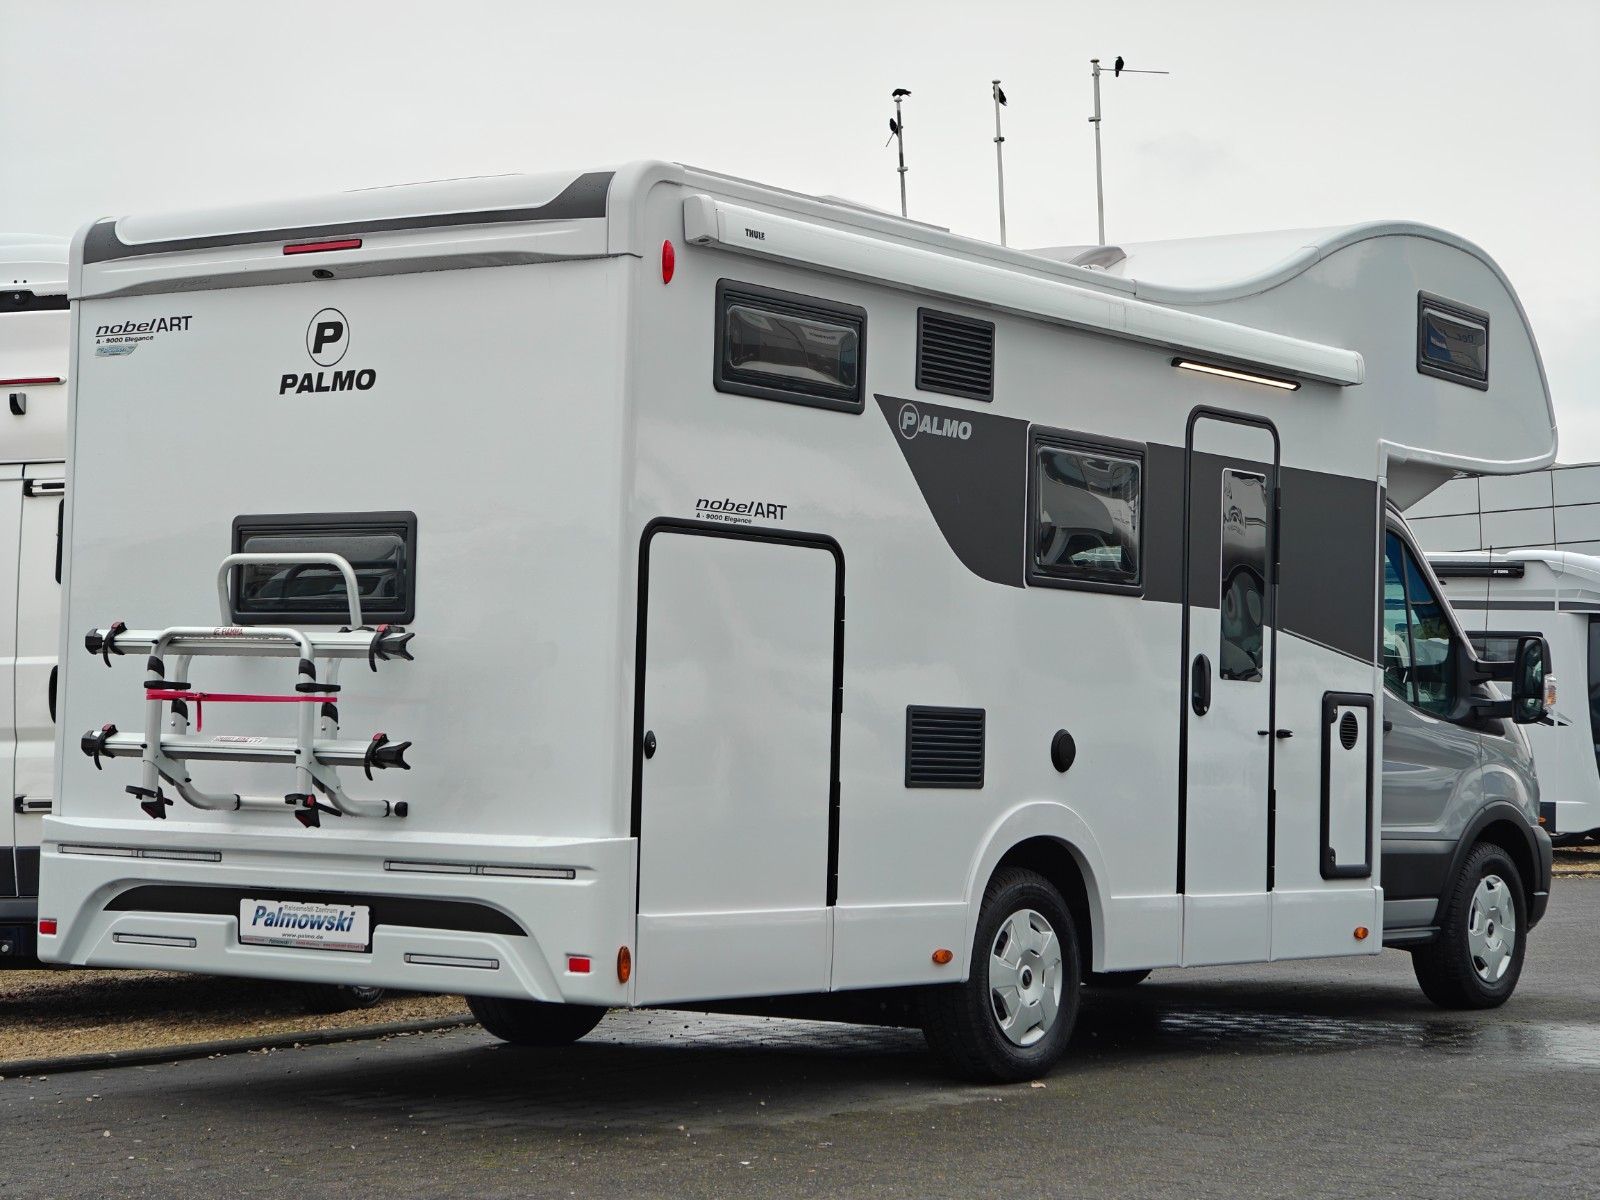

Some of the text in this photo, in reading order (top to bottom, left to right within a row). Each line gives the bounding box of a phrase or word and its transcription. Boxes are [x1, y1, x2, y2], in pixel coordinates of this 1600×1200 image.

[745, 228, 765, 240] THULE
[125, 335, 154, 343] Elegance
[313, 321, 343, 354] P
[279, 369, 377, 395] PALMO
[724, 515, 752, 524] Elegance
[252, 905, 356, 933] Palmowski
[282, 932, 323, 940] www.palmo.de
